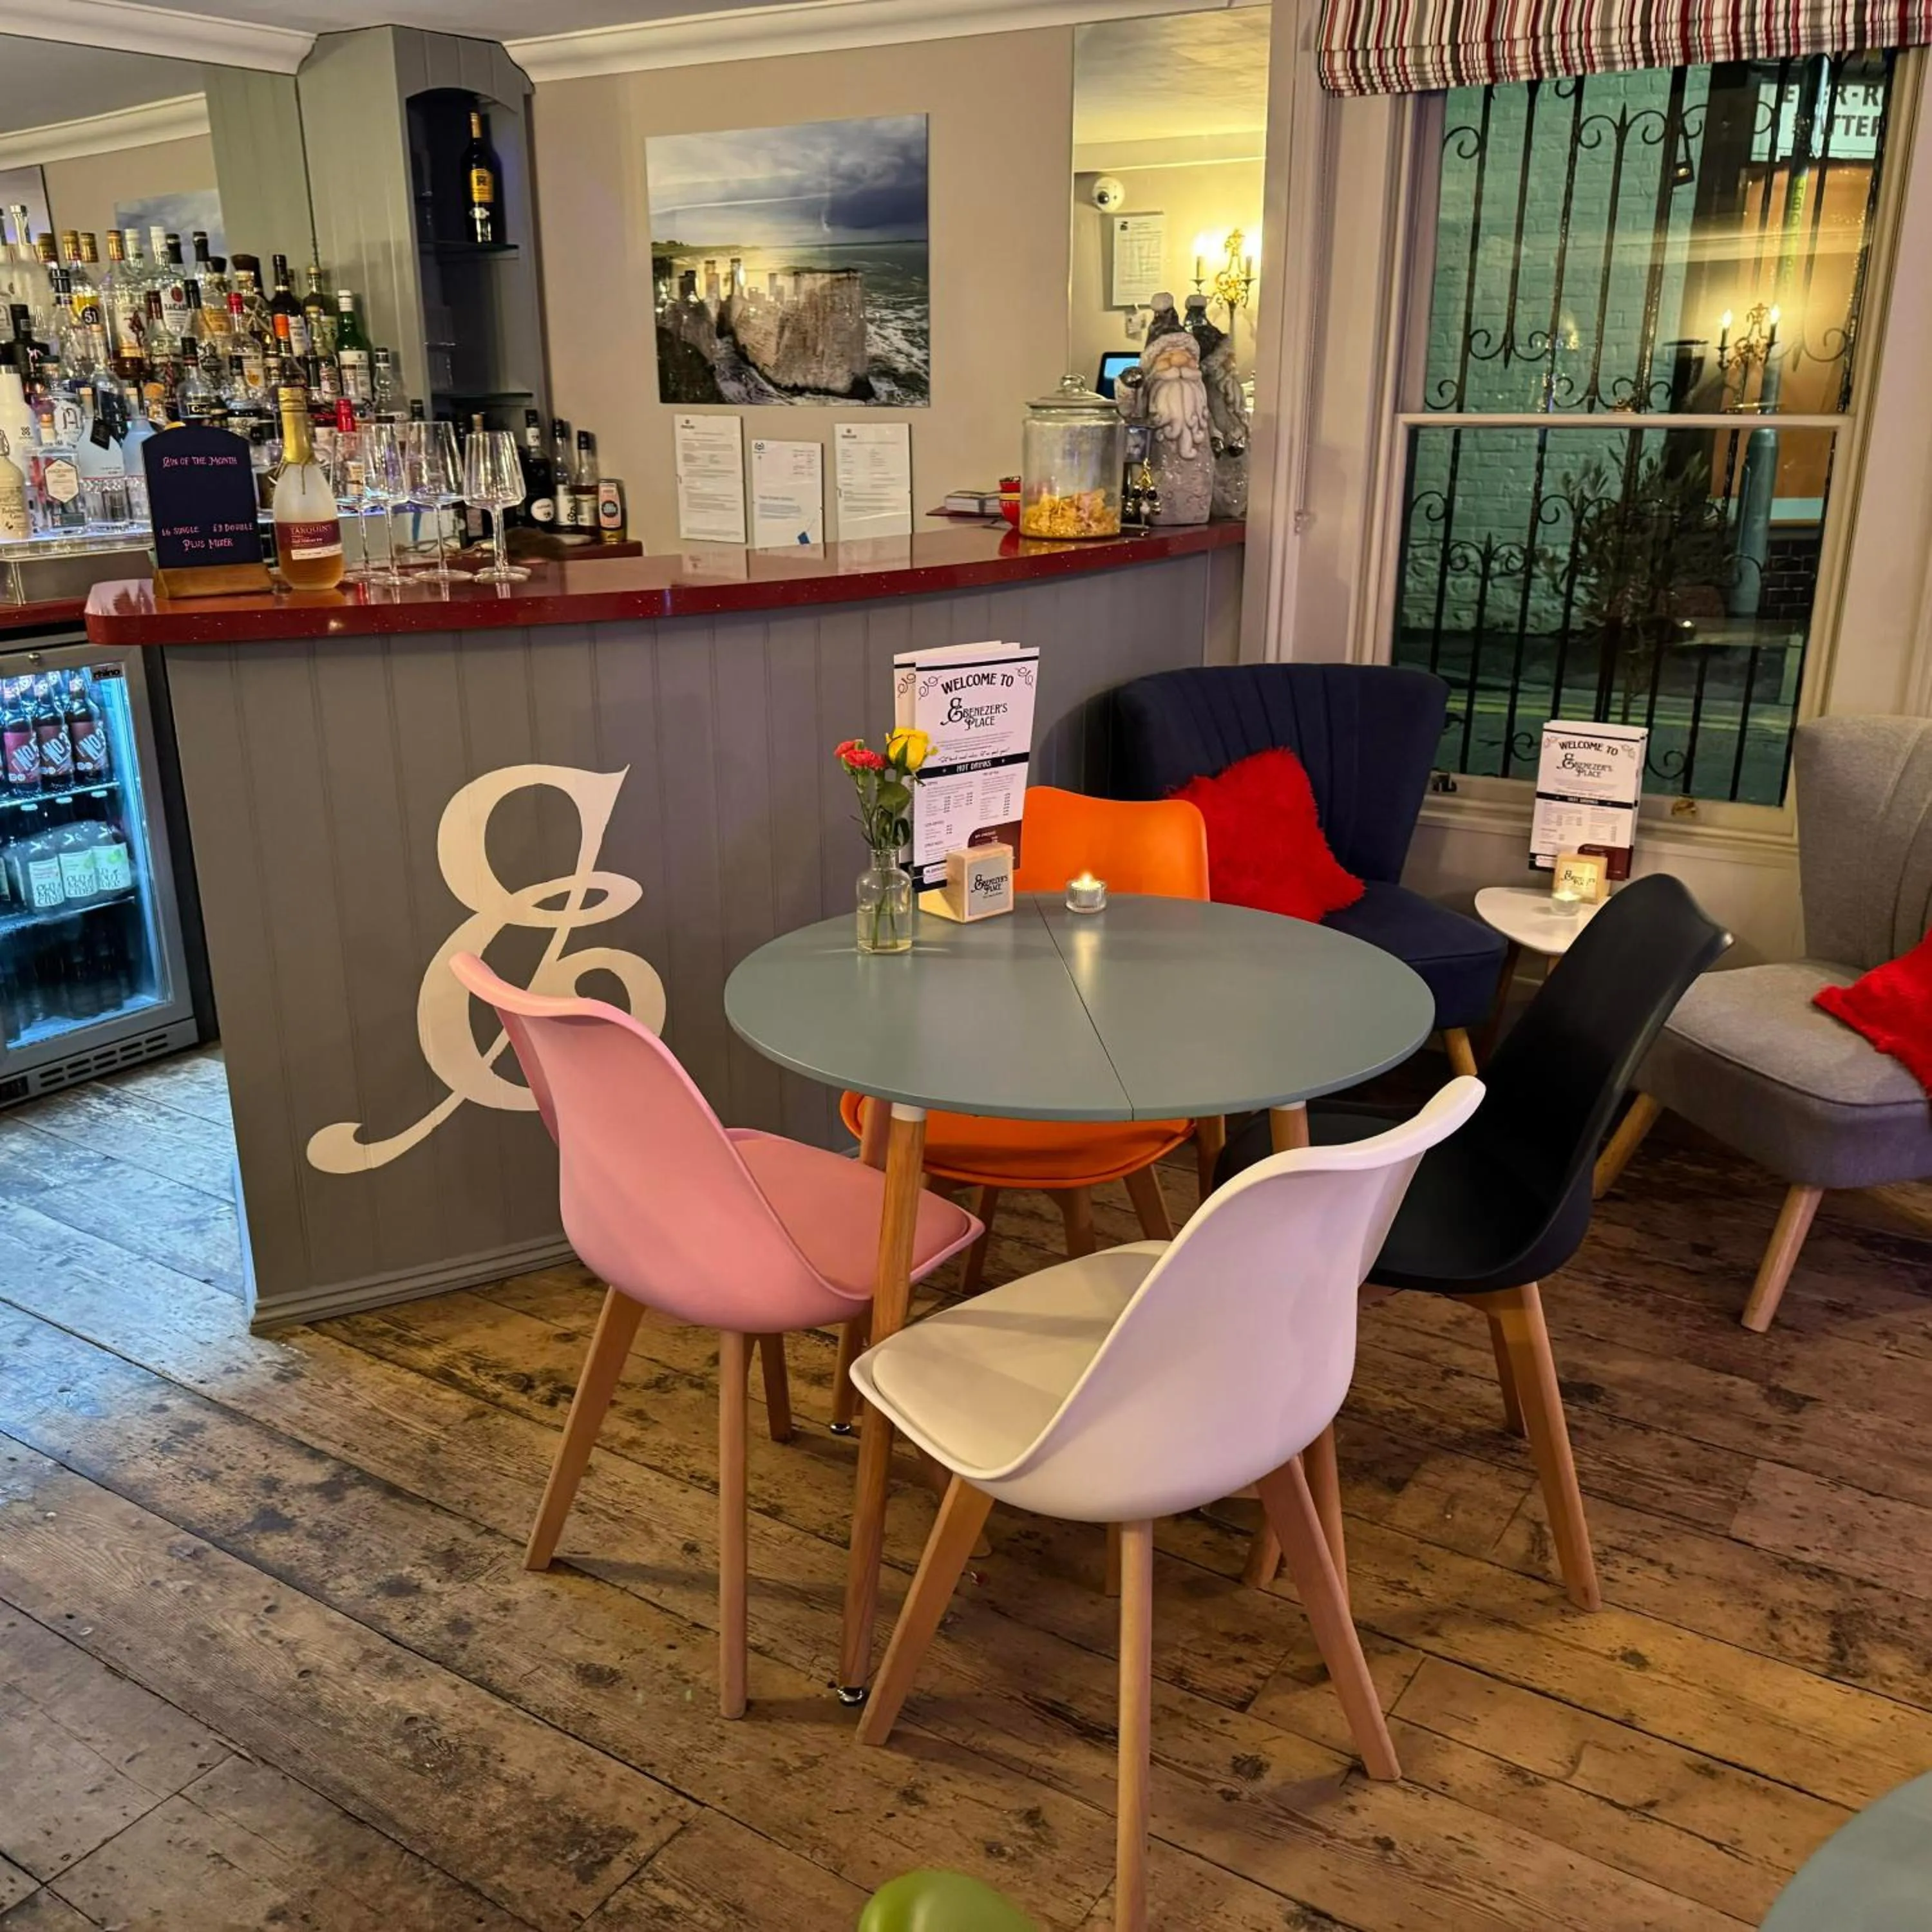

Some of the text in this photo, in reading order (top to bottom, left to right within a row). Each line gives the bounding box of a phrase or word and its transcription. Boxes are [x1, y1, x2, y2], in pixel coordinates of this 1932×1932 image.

[84, 311, 97, 323] 51
[180, 457, 189, 465] OF
[208, 457, 237, 466] MONTH
[173, 526, 201, 535] SINGLE
[224, 522, 254, 533] DOUBLE
[182, 538, 233, 552] PLUS MIXER
[941, 672, 1014, 694] WELCOME TO
[964, 716, 996, 731] PLACE
[1559, 741, 1618, 756] WELCOME TO
[956, 760, 992, 773] HOT DRINKS
